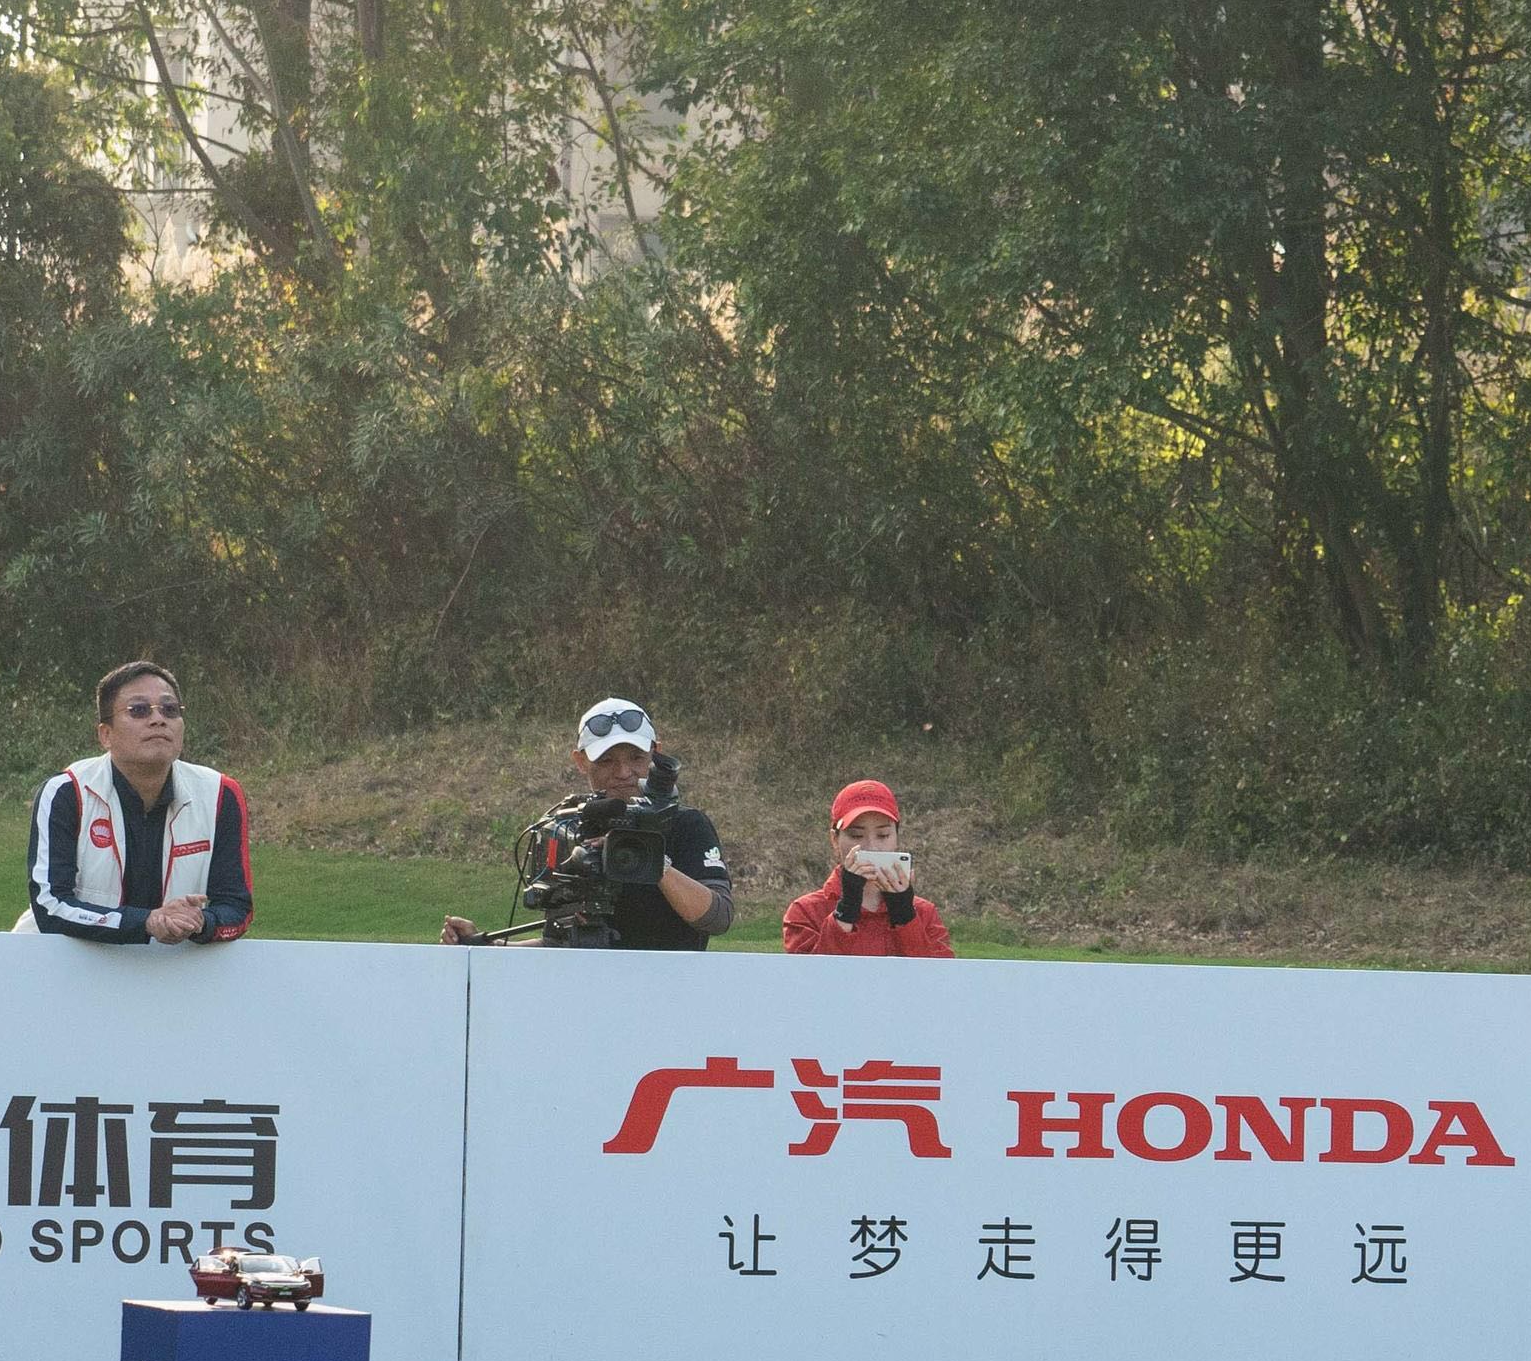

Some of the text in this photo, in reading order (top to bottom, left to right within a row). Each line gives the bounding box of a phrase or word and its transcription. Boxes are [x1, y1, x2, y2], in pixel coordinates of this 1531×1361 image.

[603, 1056, 1516, 1166] 广汽 HONDA
[30, 1218, 275, 1264] SPORTS
[718, 1213, 1408, 1284] 让梦走得更远
